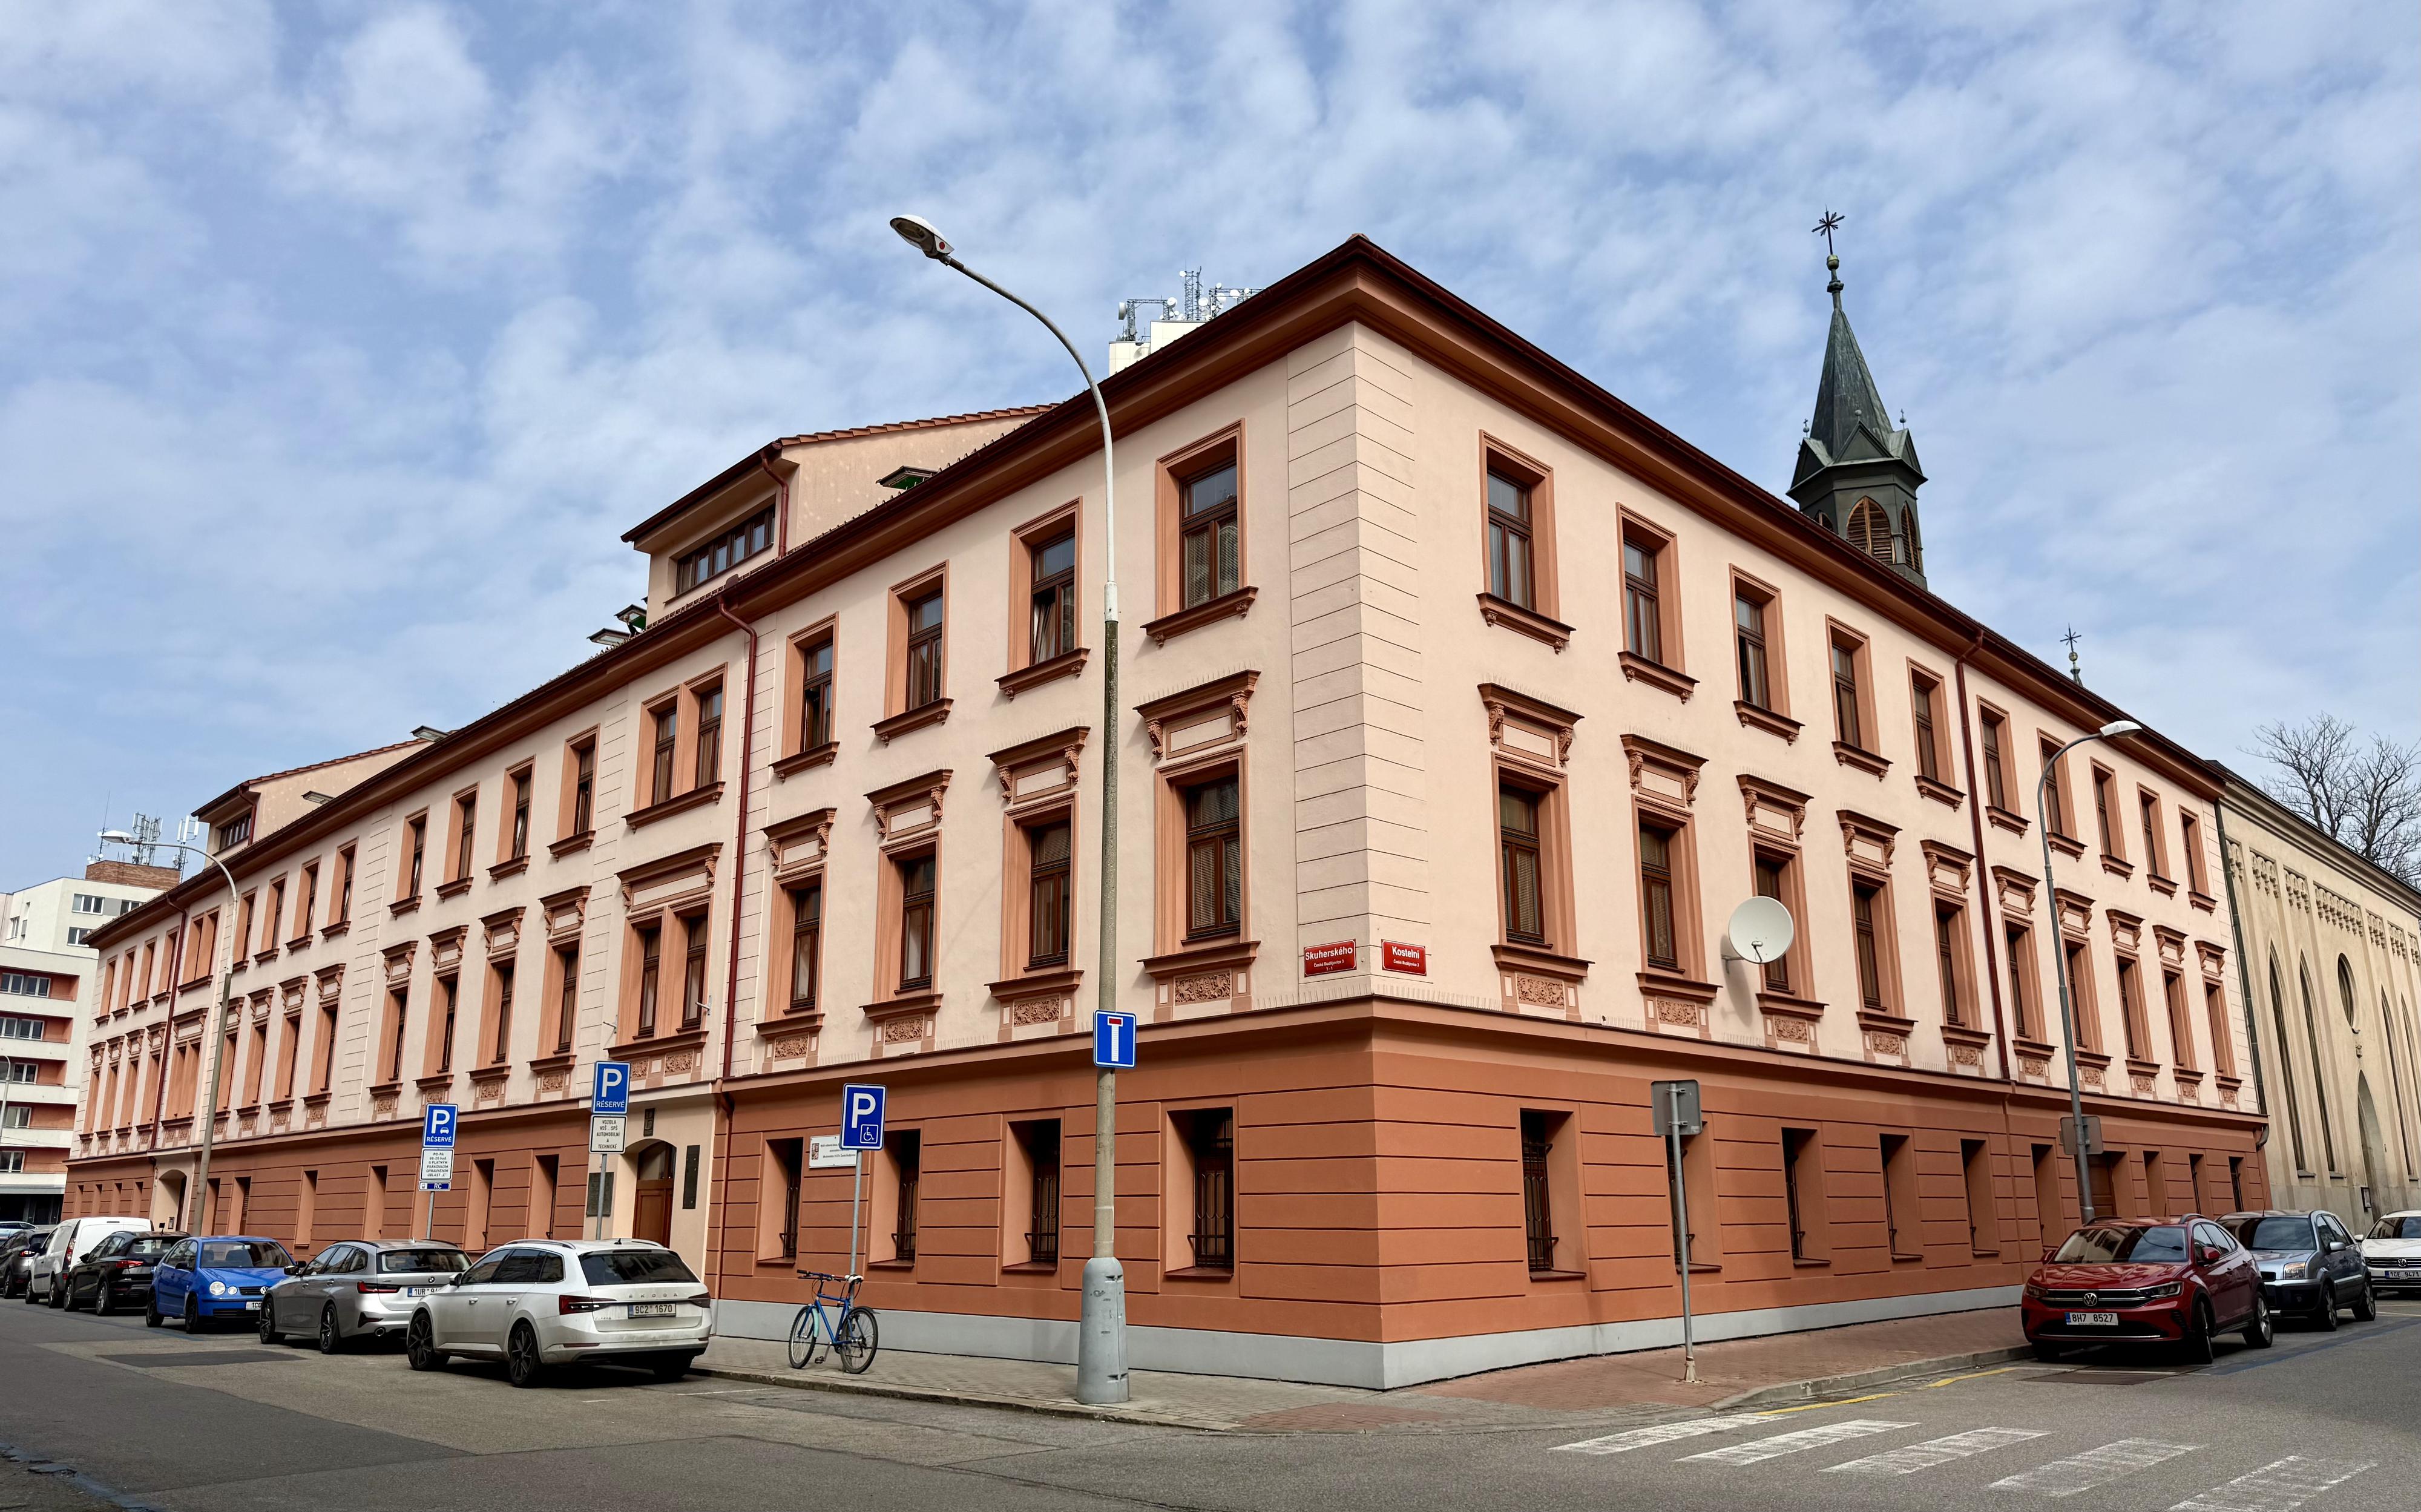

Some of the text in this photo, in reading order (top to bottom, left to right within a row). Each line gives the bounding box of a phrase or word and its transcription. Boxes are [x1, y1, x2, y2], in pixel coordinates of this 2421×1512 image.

[1306, 946, 1353, 961] Skuherského
[602, 1068, 622, 1097] P
[596, 1099, 625, 1108] RÉSERVÉ
[851, 1093, 876, 1129] P
[431, 1109, 450, 1134] P
[636, 1304, 672, 1314] 9C2 1670
[2072, 1313, 2113, 1322] 8H7 8527
